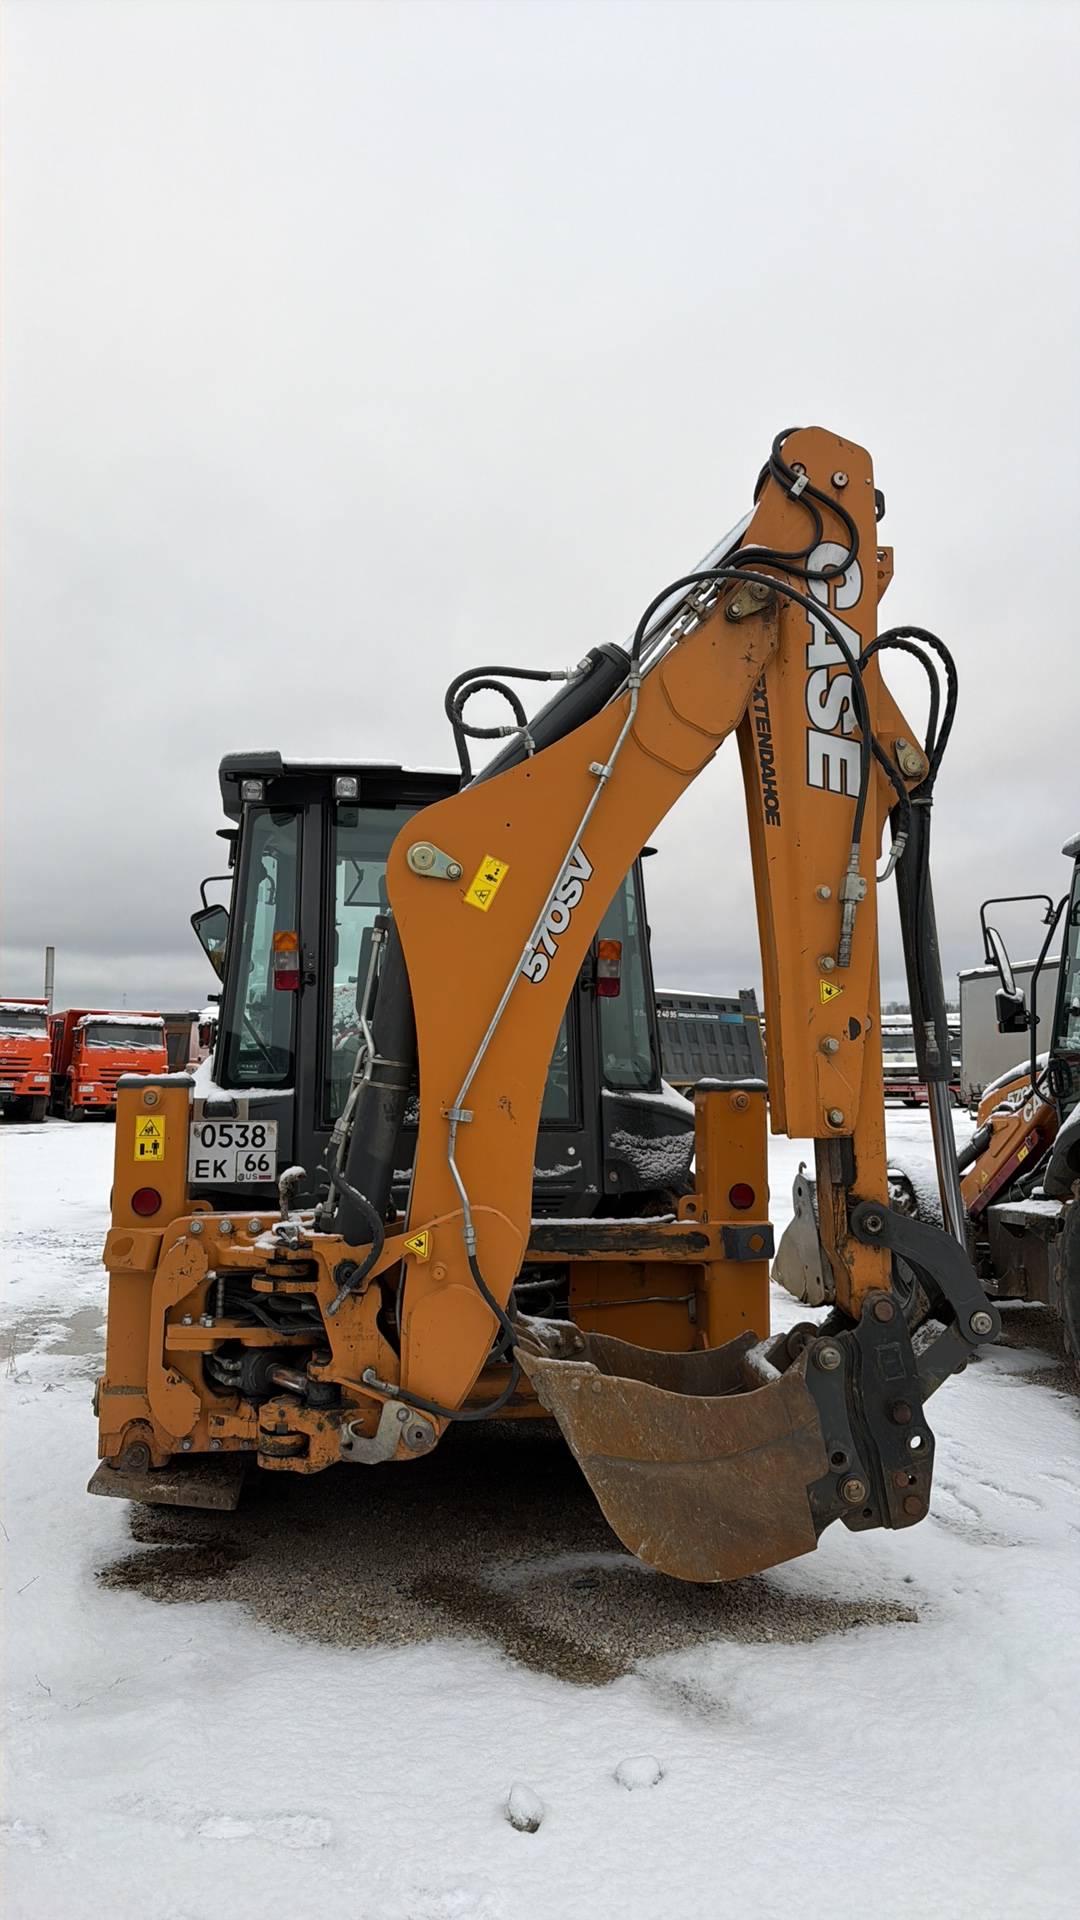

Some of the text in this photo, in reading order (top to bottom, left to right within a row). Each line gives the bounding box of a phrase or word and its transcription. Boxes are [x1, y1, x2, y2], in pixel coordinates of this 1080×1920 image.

[806, 541, 863, 799] CASE
[522, 844, 594, 983] 570SV
[195, 1153, 270, 1178] EK 66
[201, 1124, 266, 1148] 0538
